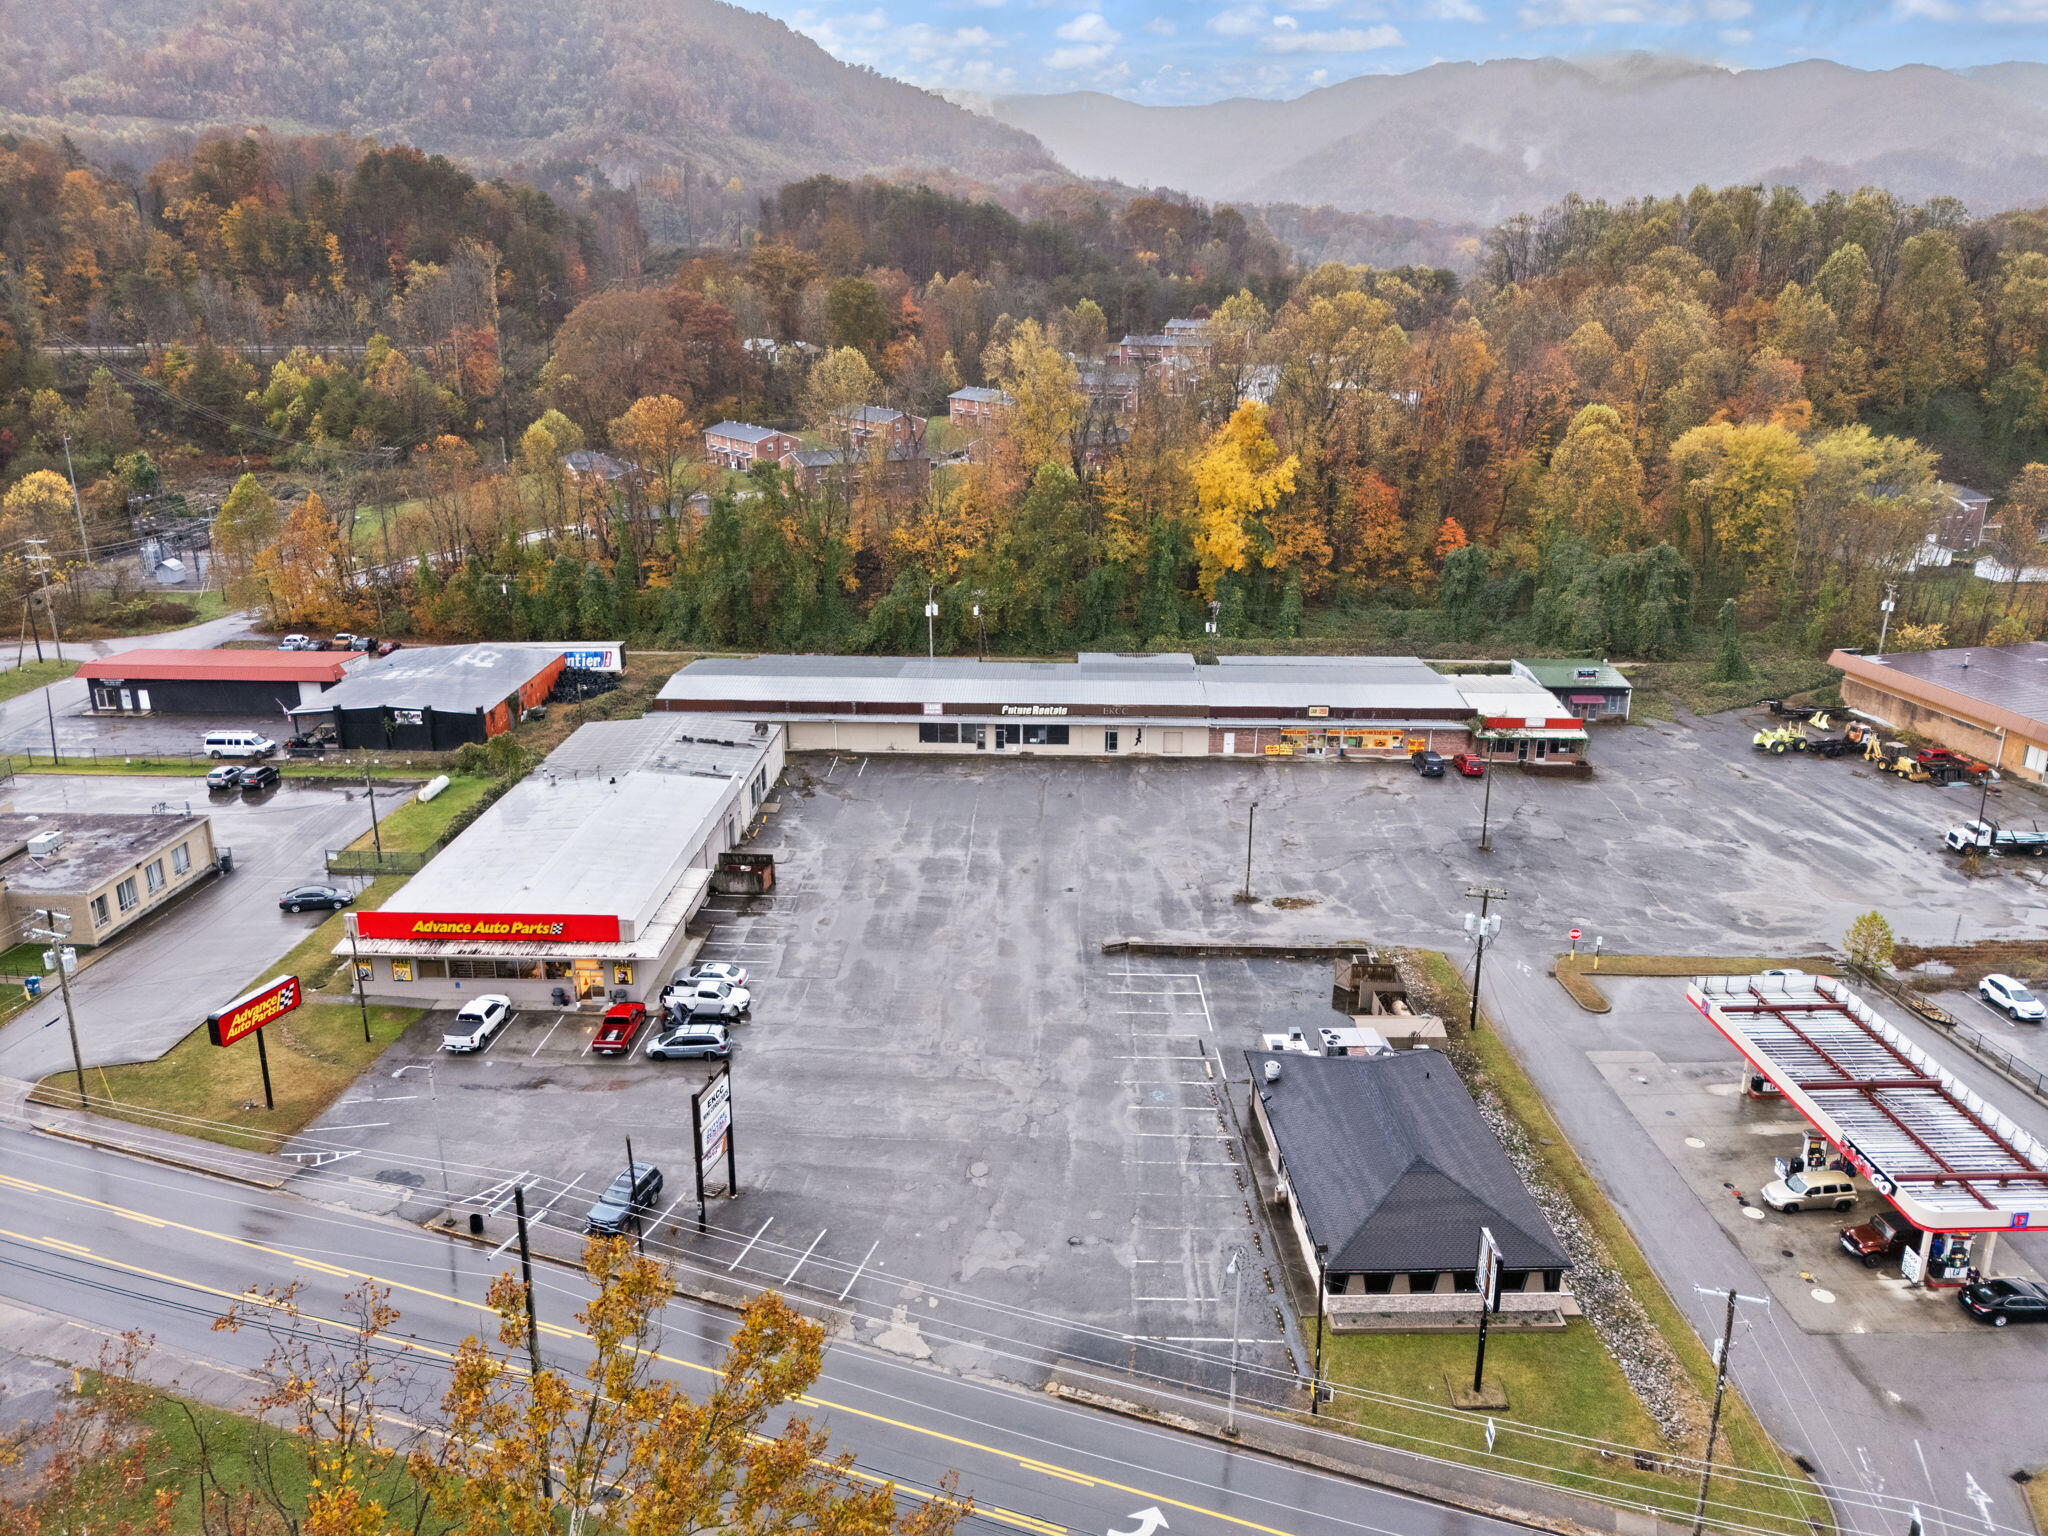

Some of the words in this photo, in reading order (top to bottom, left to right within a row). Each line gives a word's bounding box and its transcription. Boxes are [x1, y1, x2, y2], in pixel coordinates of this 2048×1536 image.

[1002, 705, 1032, 715] Future
[1032, 705, 1068, 715] Rentals
[1103, 707, 1128, 715] EKCC
[412, 920, 471, 933] Advance
[473, 921, 512, 934] Auto
[511, 922, 550, 934] Parts
[226, 1020, 251, 1040] Auto
[251, 1005, 277, 1025] Parts
[231, 995, 278, 1028] Advance
[707, 1085, 724, 1108] EKCC
[1871, 1173, 1892, 1195] GO
